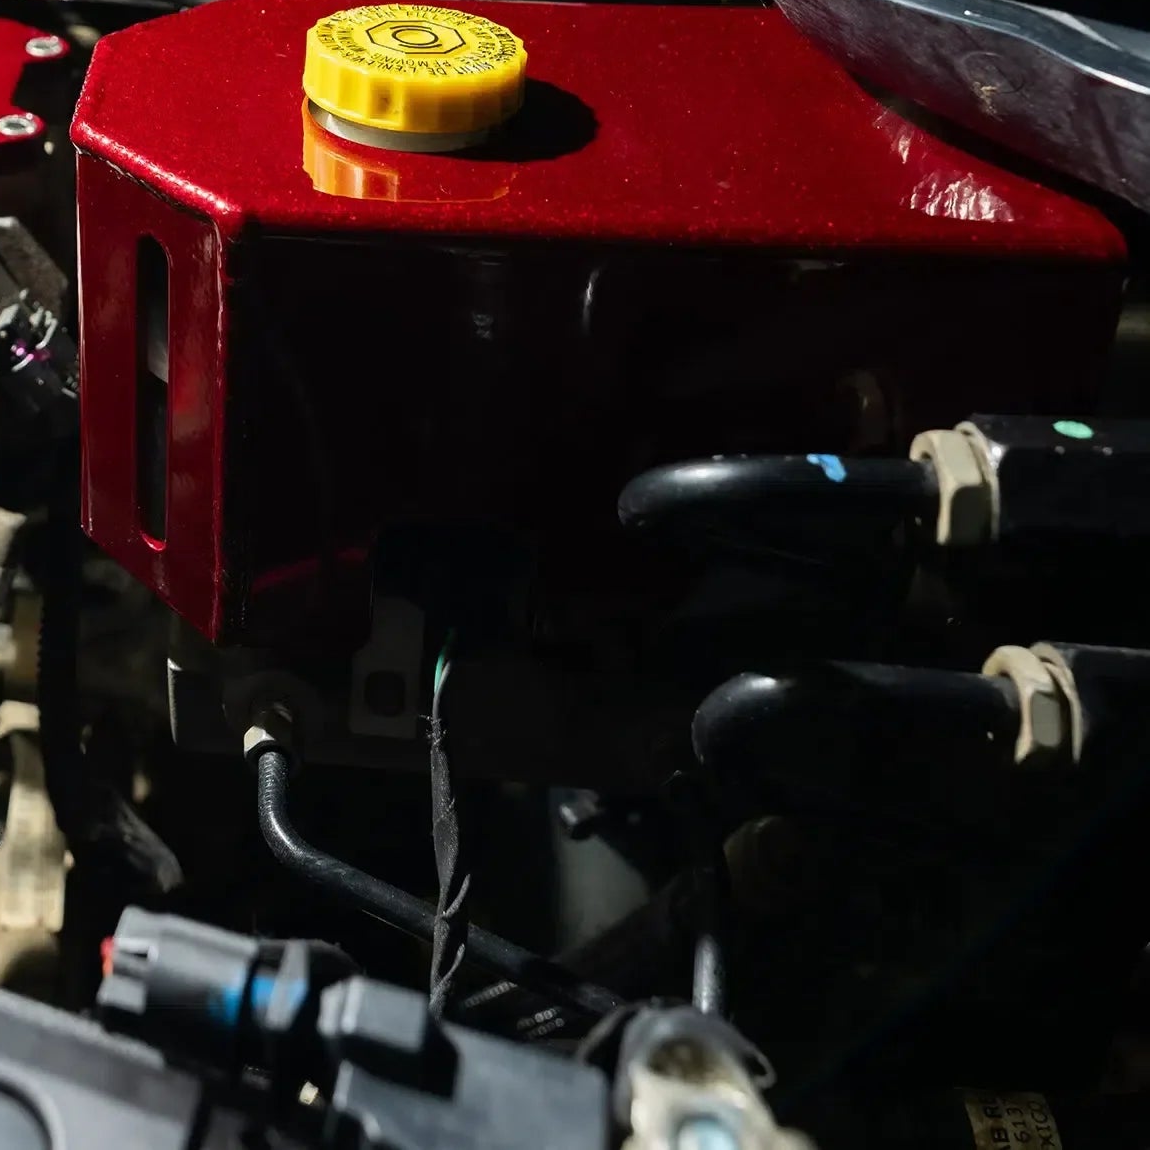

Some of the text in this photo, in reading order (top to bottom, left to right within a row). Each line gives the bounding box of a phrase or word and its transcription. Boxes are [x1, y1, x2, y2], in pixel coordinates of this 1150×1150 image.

[406, 11, 466, 26] FILLER
[469, 27, 492, 39] CAP
[371, 53, 452, 68] REMOVING
[430, 67, 447, 75] DE
